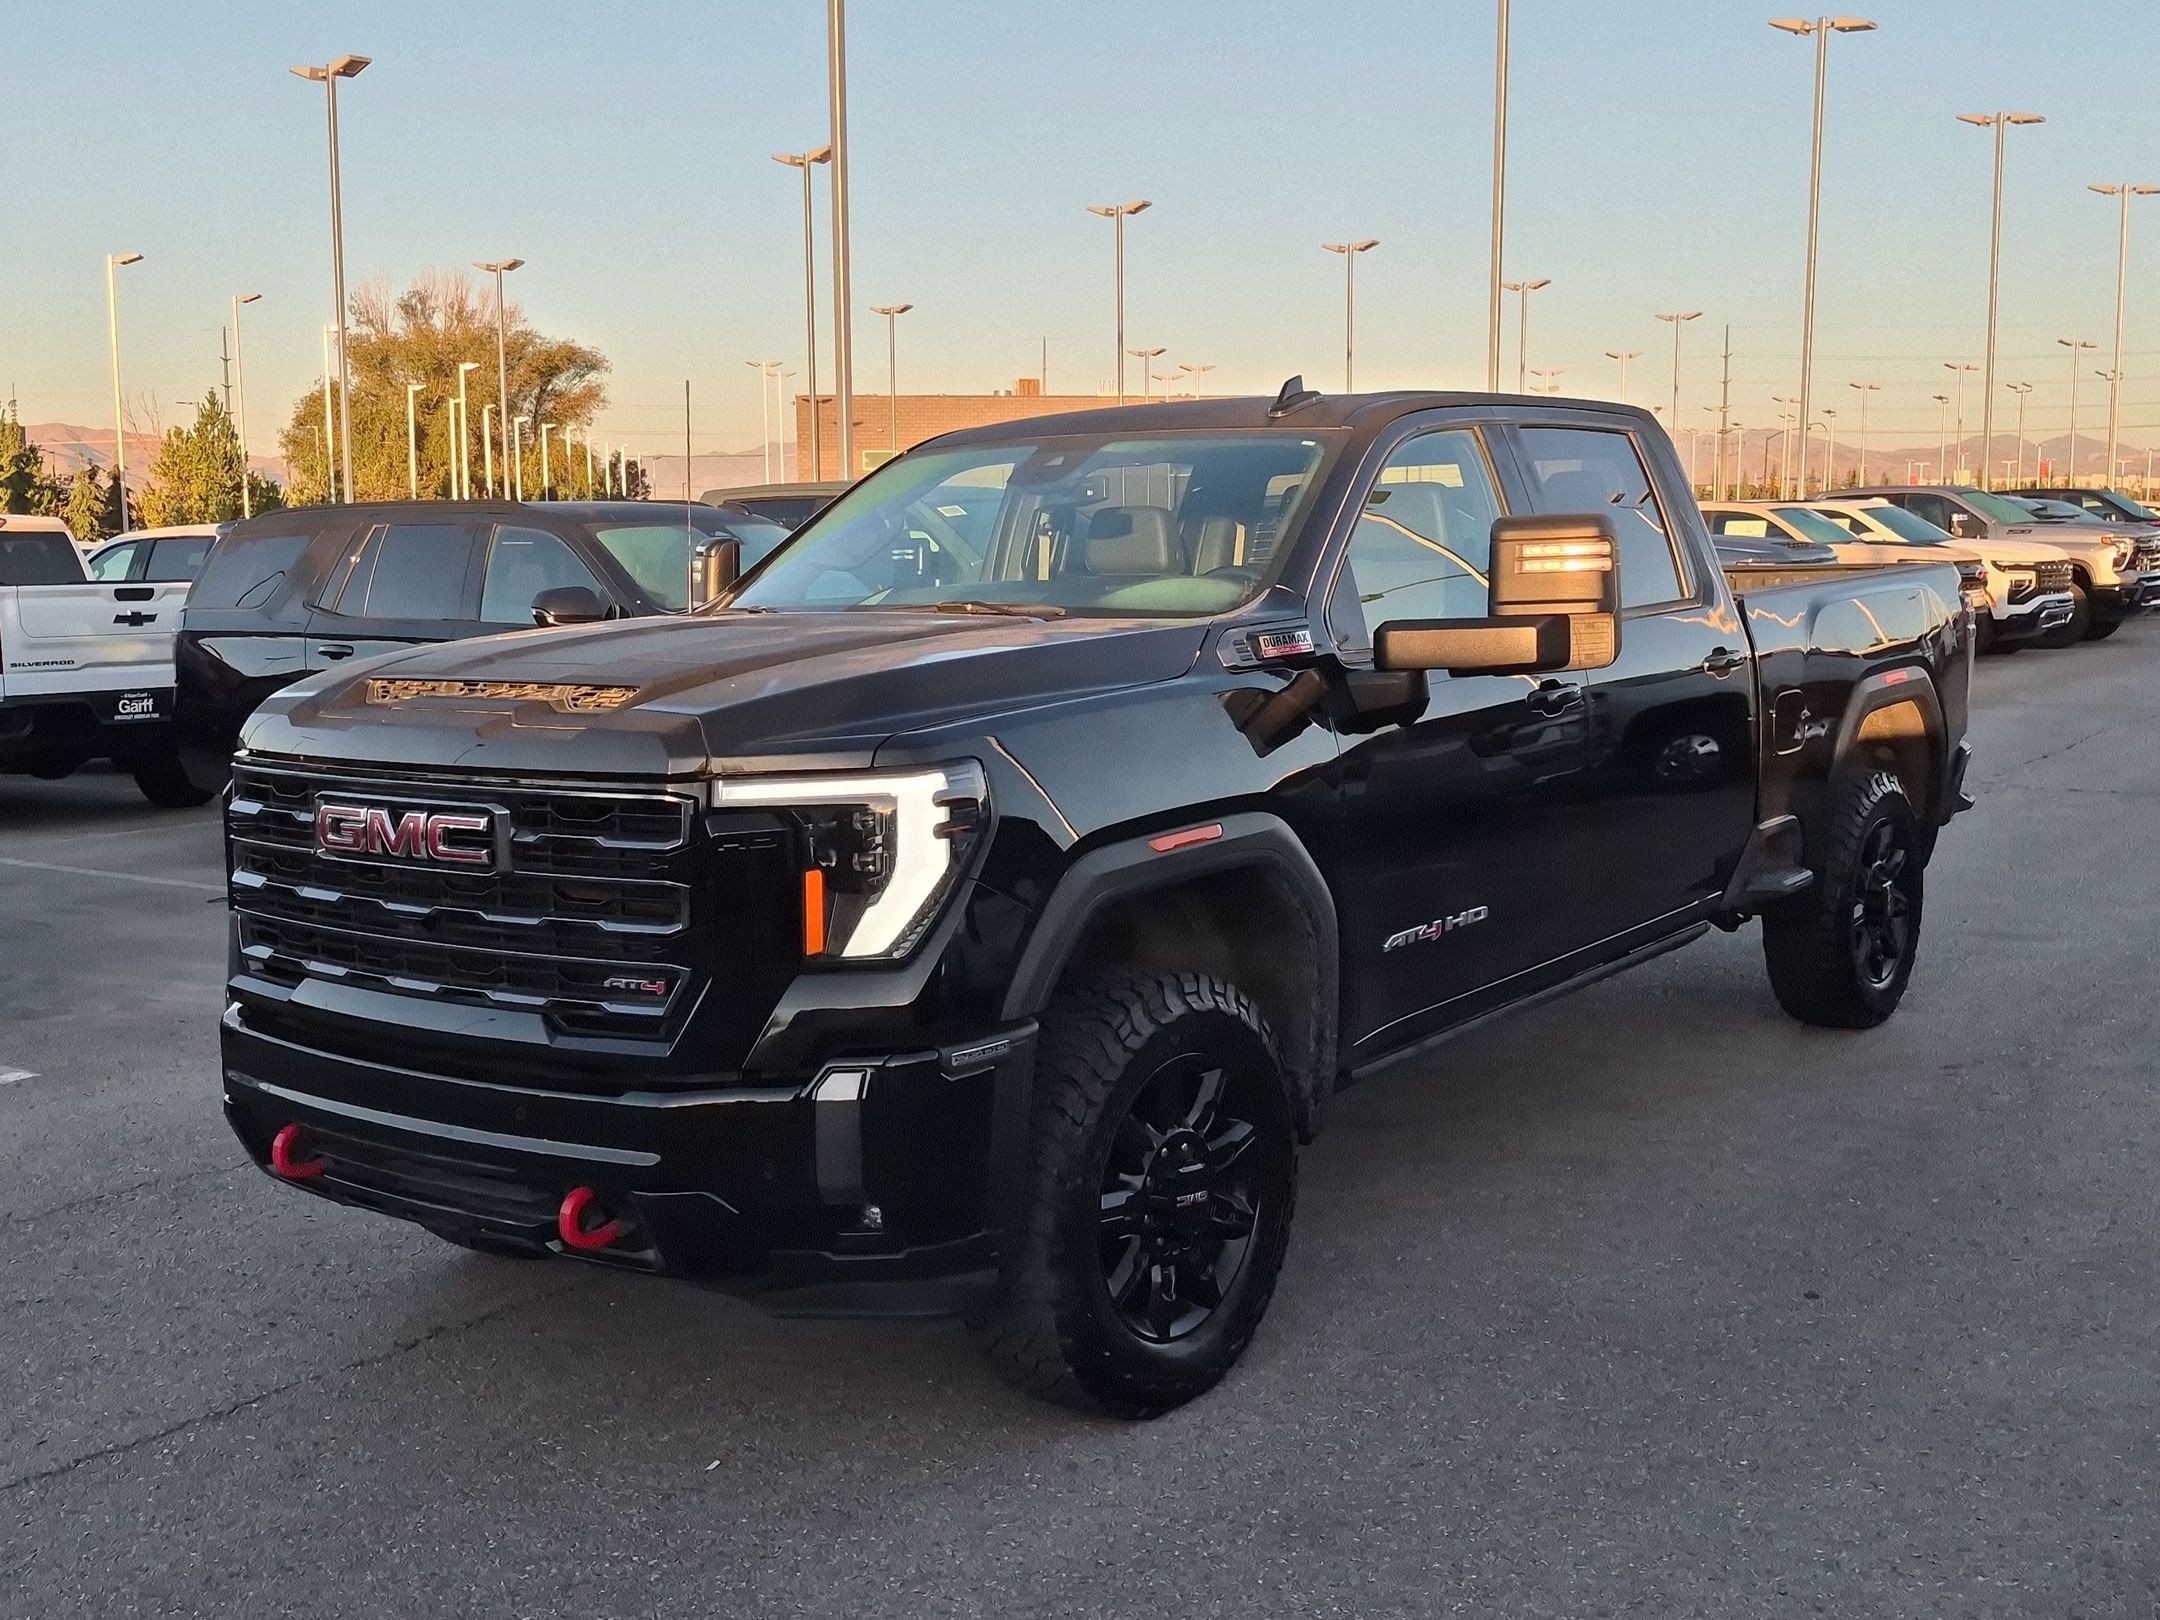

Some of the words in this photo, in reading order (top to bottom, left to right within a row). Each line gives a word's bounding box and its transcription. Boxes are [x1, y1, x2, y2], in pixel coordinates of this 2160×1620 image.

[1262, 632, 1308, 648] DURAMAX
[118, 698, 153, 713] Garff
[318, 805, 489, 863] GMC
[1383, 919, 1442, 952] AT4
[1445, 905, 1488, 931] HD
[603, 978, 665, 995] AT4
